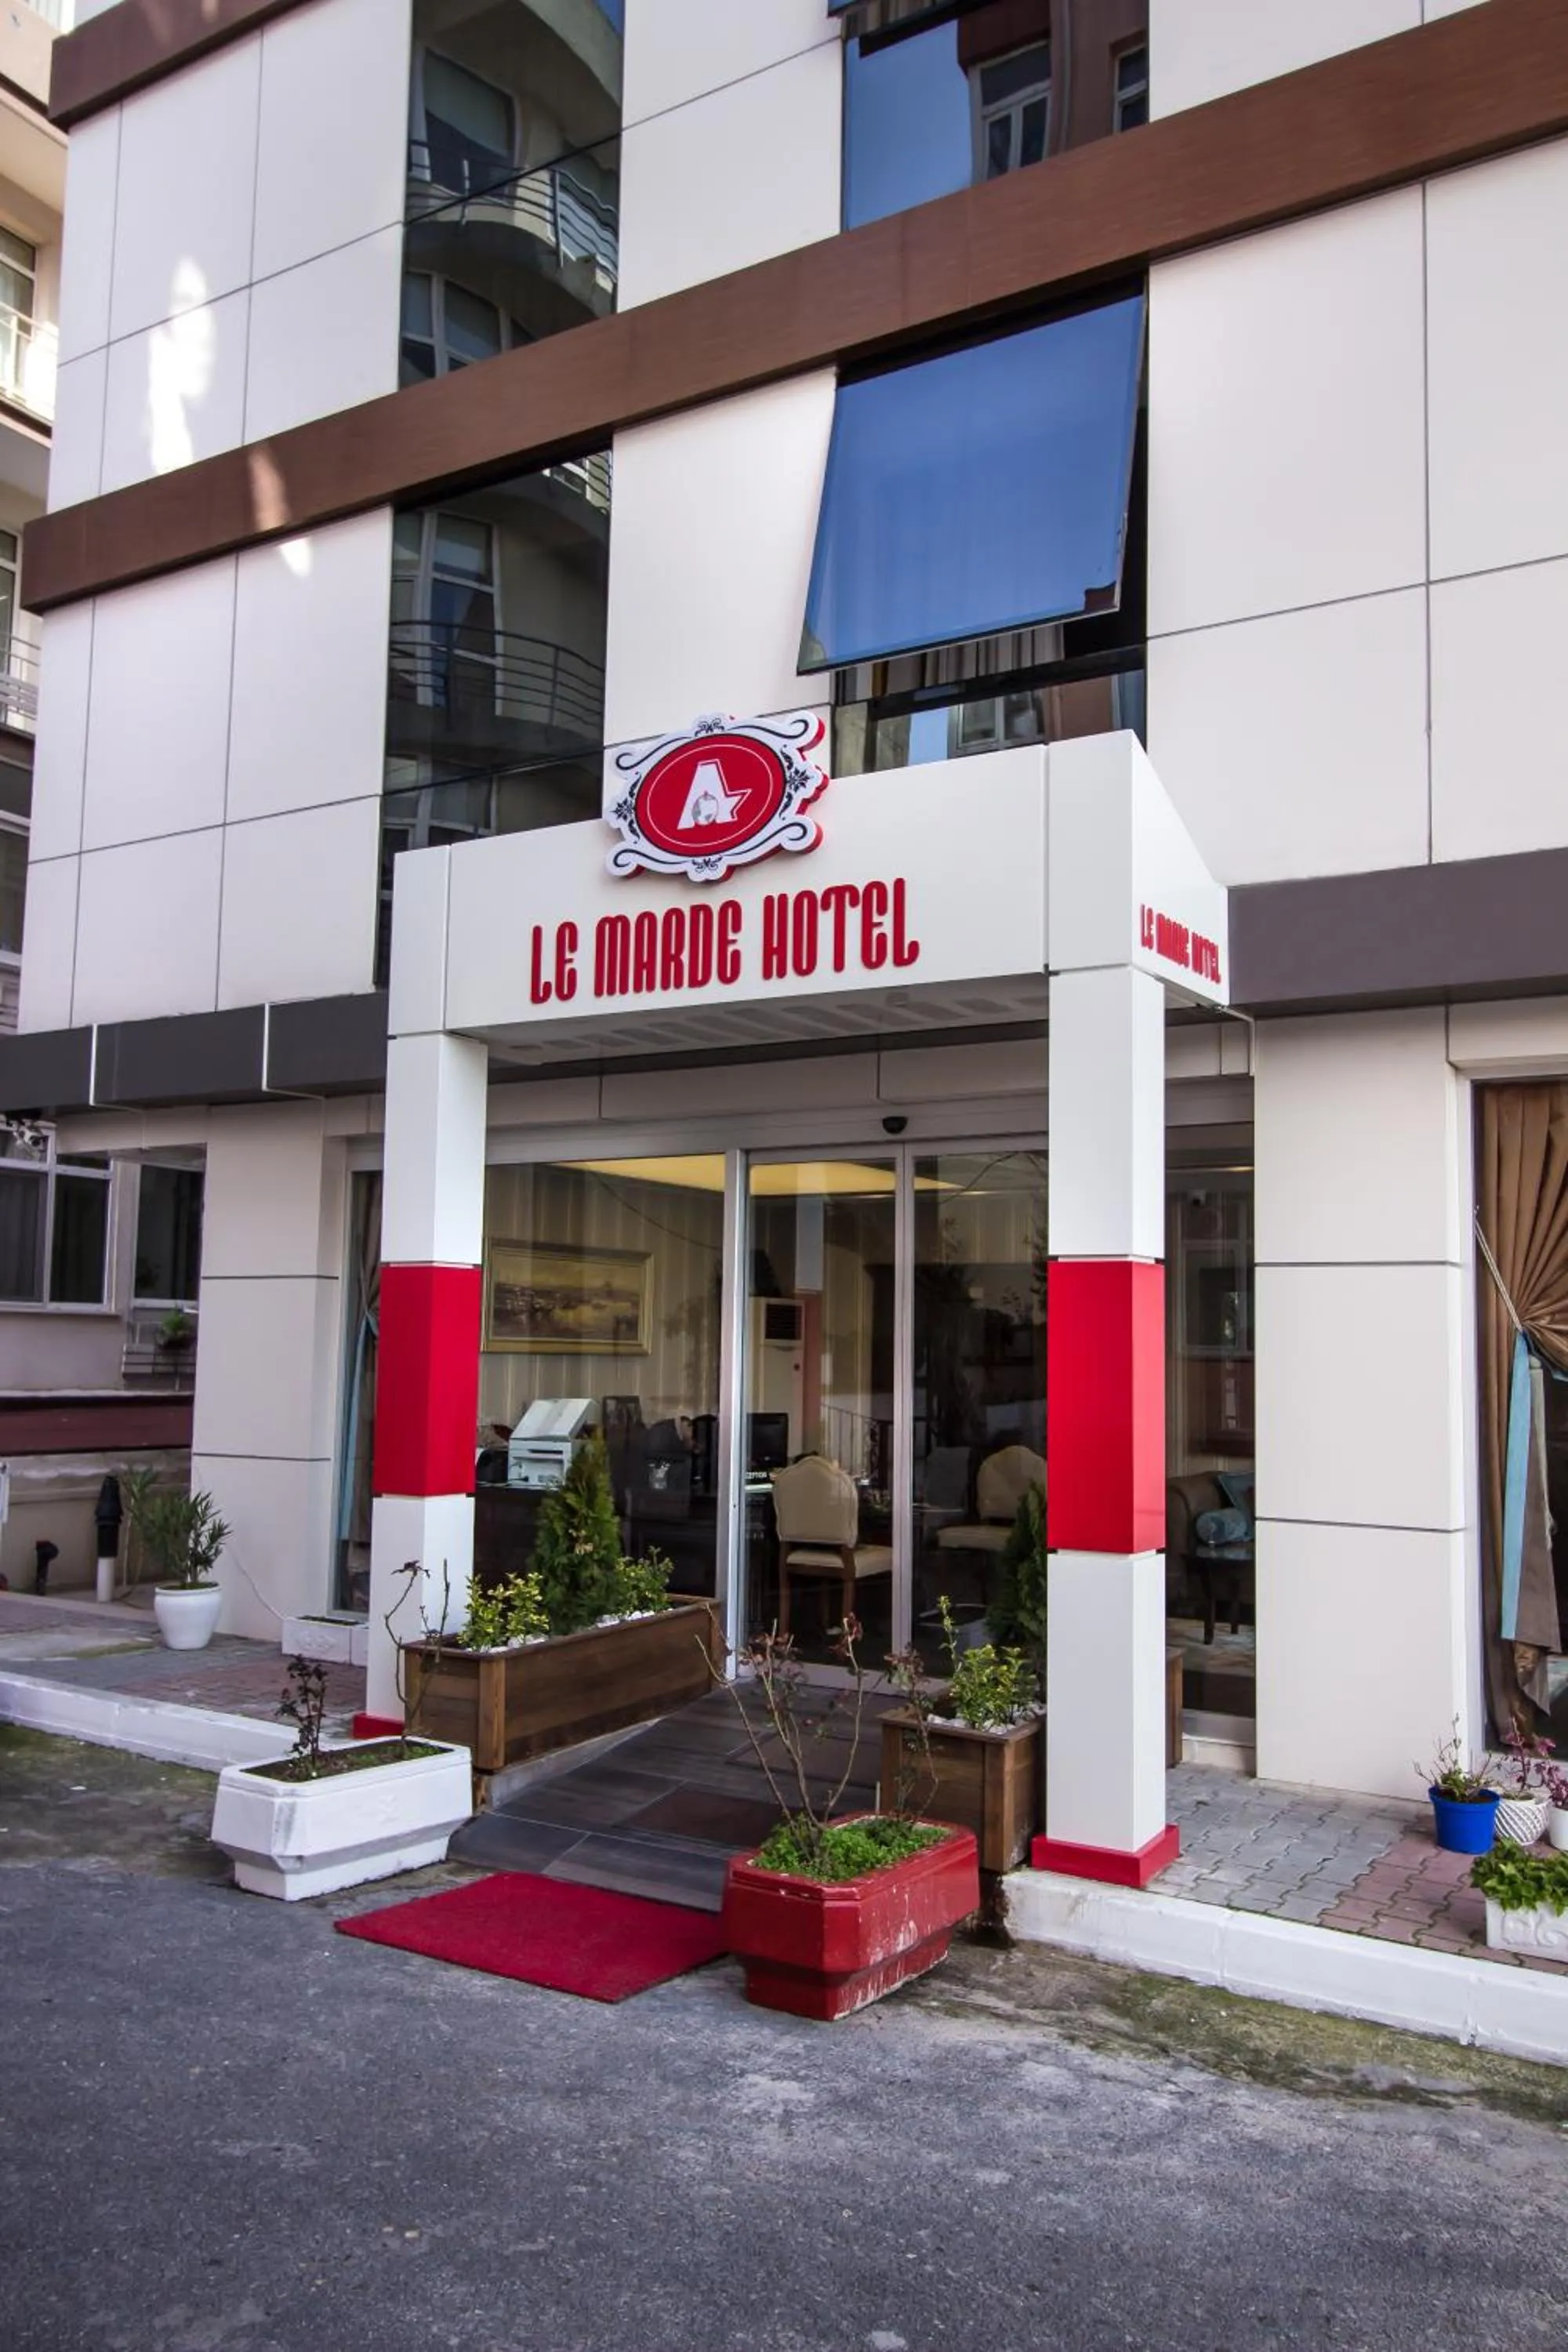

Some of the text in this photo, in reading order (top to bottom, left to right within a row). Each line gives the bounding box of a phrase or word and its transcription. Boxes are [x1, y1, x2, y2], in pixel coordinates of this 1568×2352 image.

[530, 877, 920, 1004] LE MARDE HOTEL
